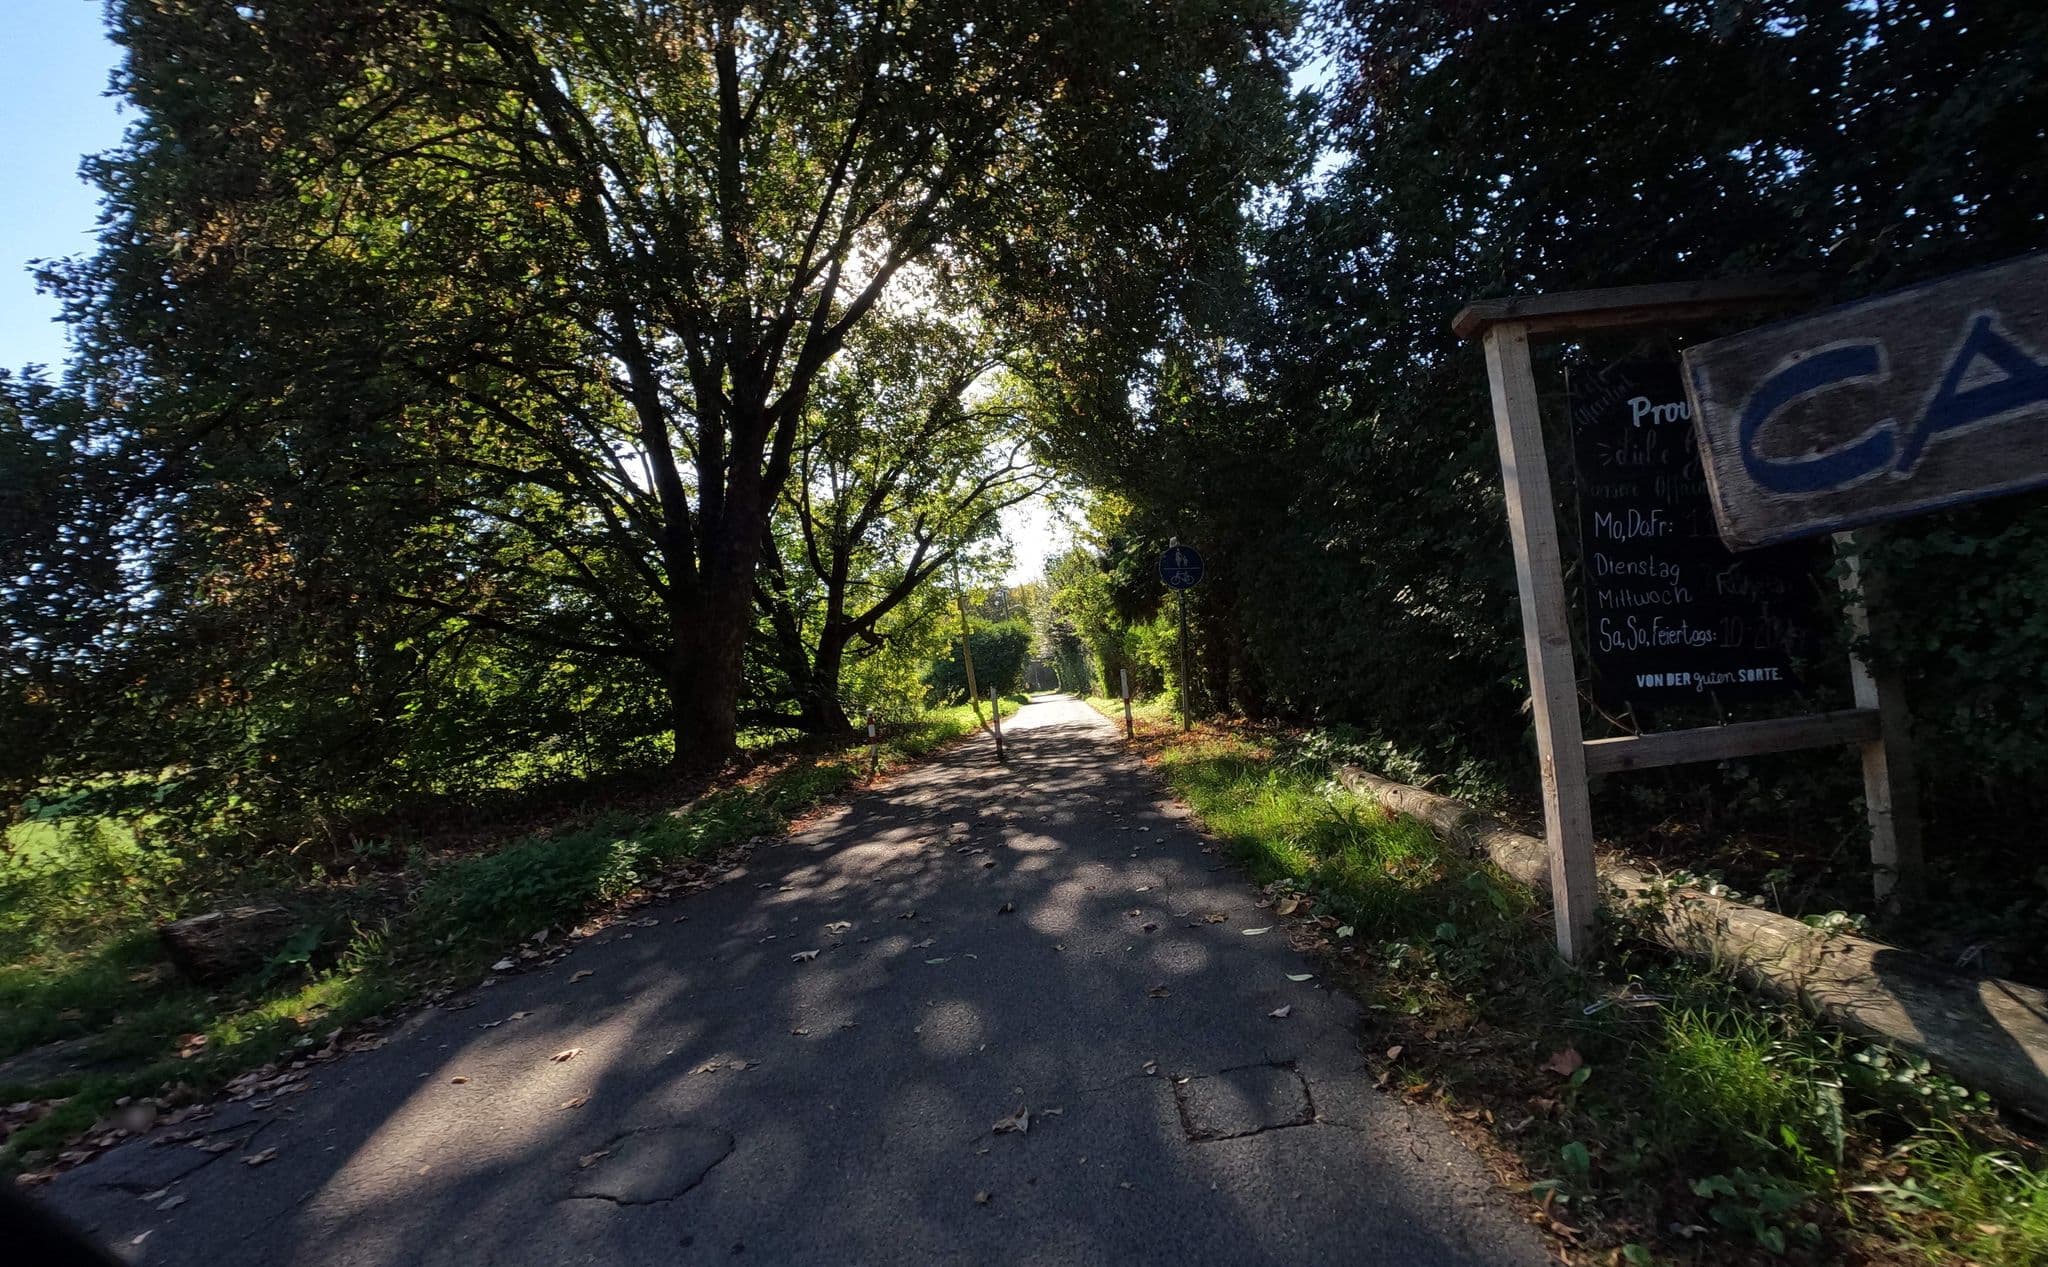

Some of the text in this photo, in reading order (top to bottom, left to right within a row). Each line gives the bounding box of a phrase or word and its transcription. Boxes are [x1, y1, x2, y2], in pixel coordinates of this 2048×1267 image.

[1593, 552, 1680, 586] Dienstag
[1599, 586, 1693, 609] Mittwoch
[1636, 673, 1664, 688] VON
[1666, 672, 1692, 687] DER
